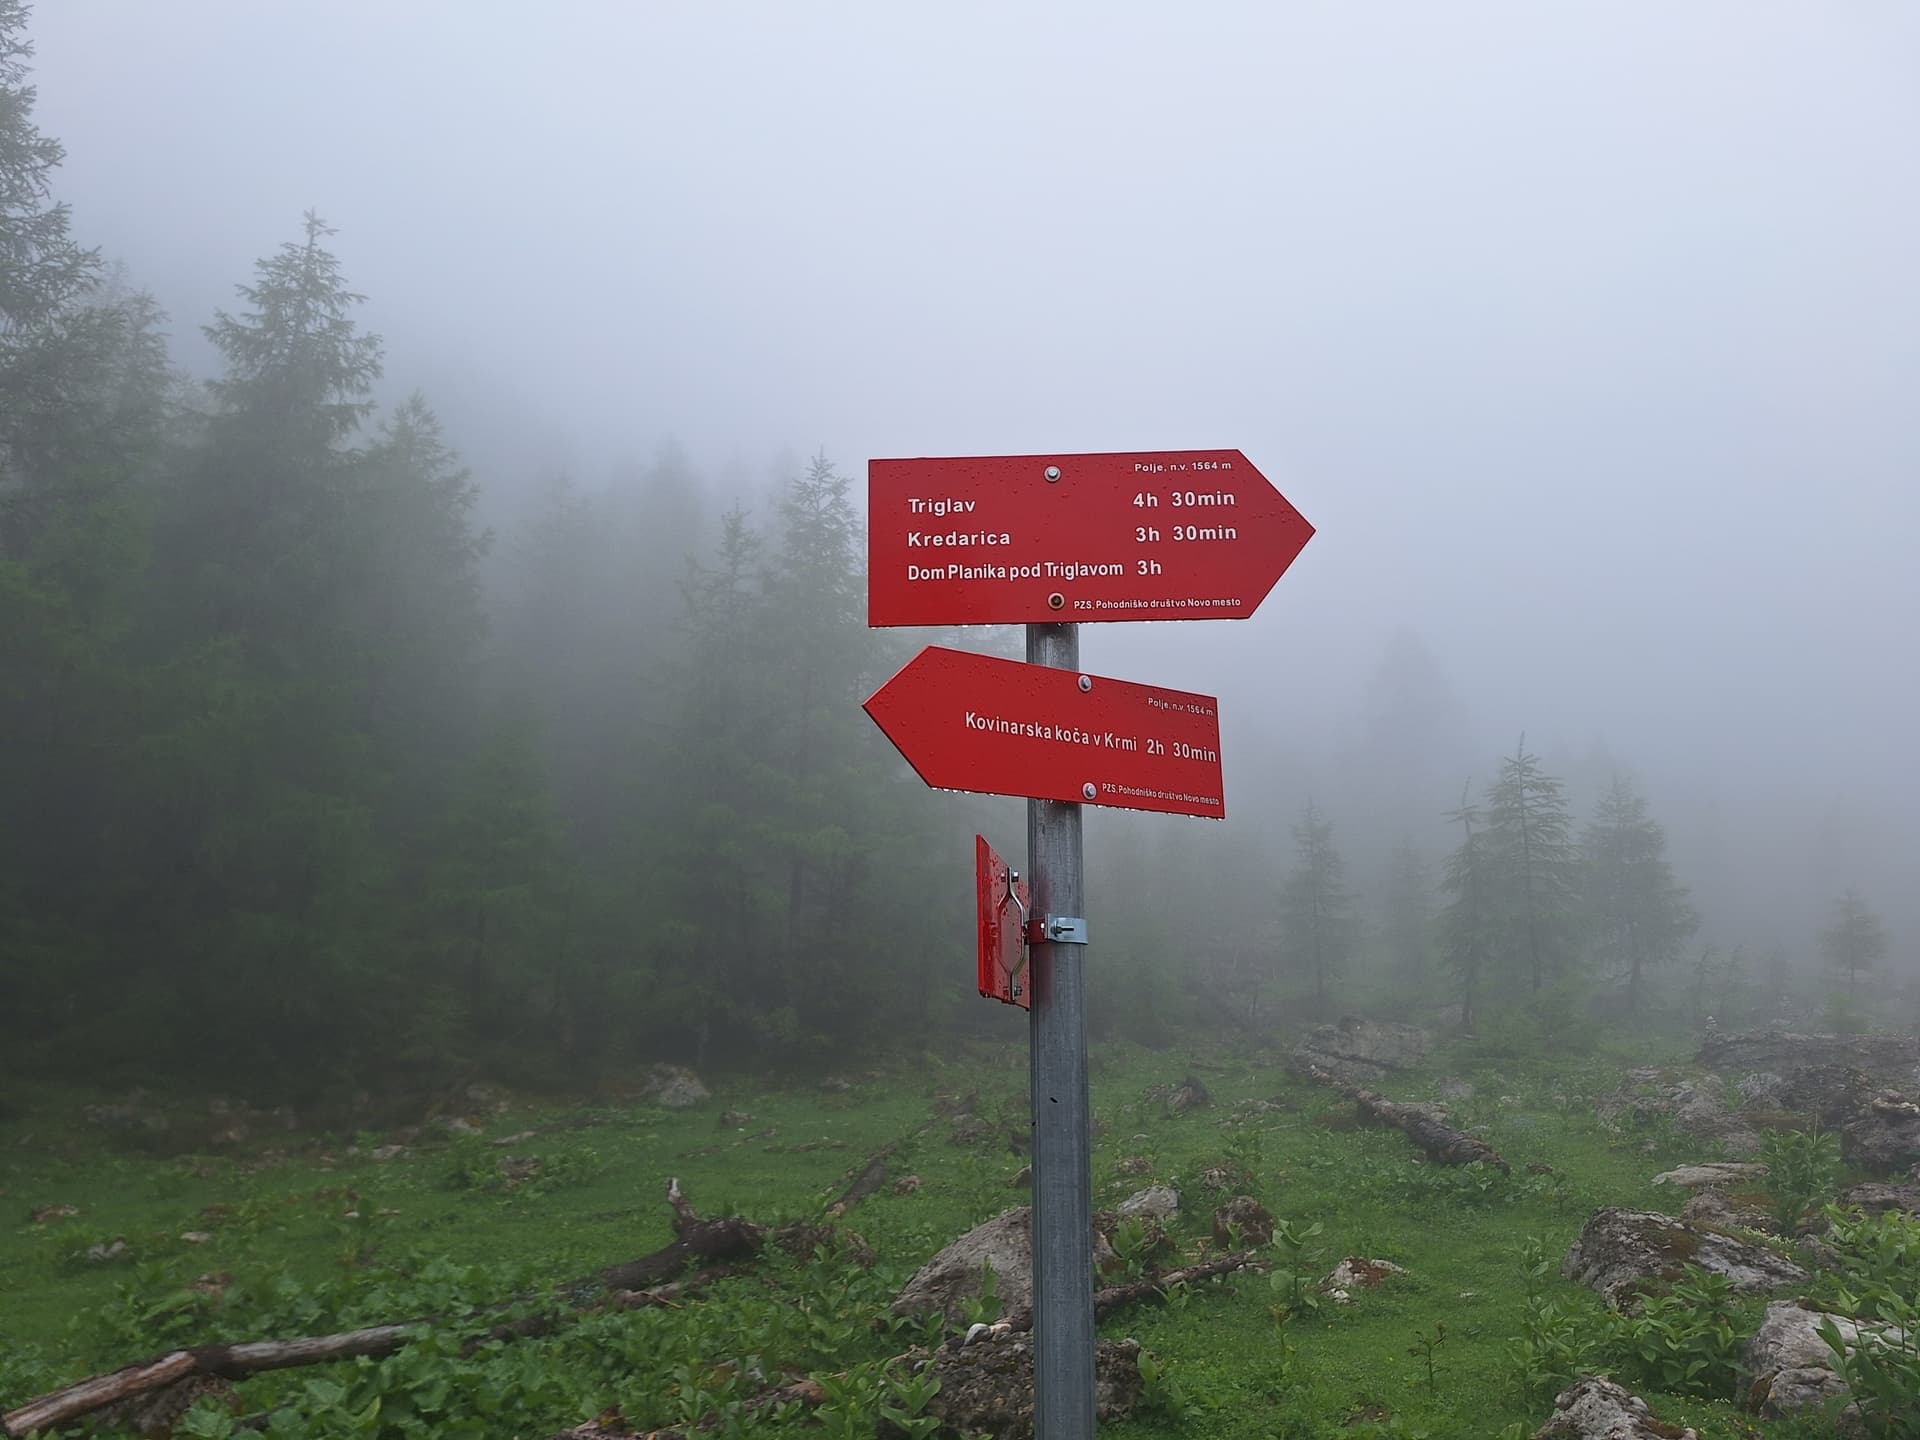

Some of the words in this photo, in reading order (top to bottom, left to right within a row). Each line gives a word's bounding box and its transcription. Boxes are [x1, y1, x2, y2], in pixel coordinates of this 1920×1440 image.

[1134, 463, 1167, 474] Polje,
[1191, 461, 1218, 471] 1564
[1221, 462, 1232, 470] m
[907, 497, 976, 517] Triglav
[1133, 492, 1158, 508] 4h
[1171, 490, 1235, 507] 30min
[908, 530, 1010, 547] Kredarica
[1135, 526, 1160, 542] 3h
[1173, 524, 1237, 541] 30min
[908, 565, 945, 581] Dom
[948, 563, 1007, 580] Planika
[1009, 562, 1041, 582] pod
[1043, 561, 1124, 581] Triglavom
[1137, 559, 1162, 576] 3h
[1073, 600, 1095, 610] PZS,
[1095, 599, 1149, 609] Pohodniško
[1150, 598, 1186, 608] društvo
[1187, 598, 1211, 607] Novo
[1212, 598, 1241, 607] mesto
[965, 711, 1052, 739] Kovinarska
[1055, 724, 1090, 745] koča
[1092, 734, 1101, 746] v
[1104, 732, 1138, 751] Krmi
[1146, 738, 1165, 756] 2h
[1172, 742, 1217, 763] 30min
[1157, 790, 1183, 801] društvo
[1183, 793, 1200, 803] Novo
[1200, 796, 1220, 806] mesto
